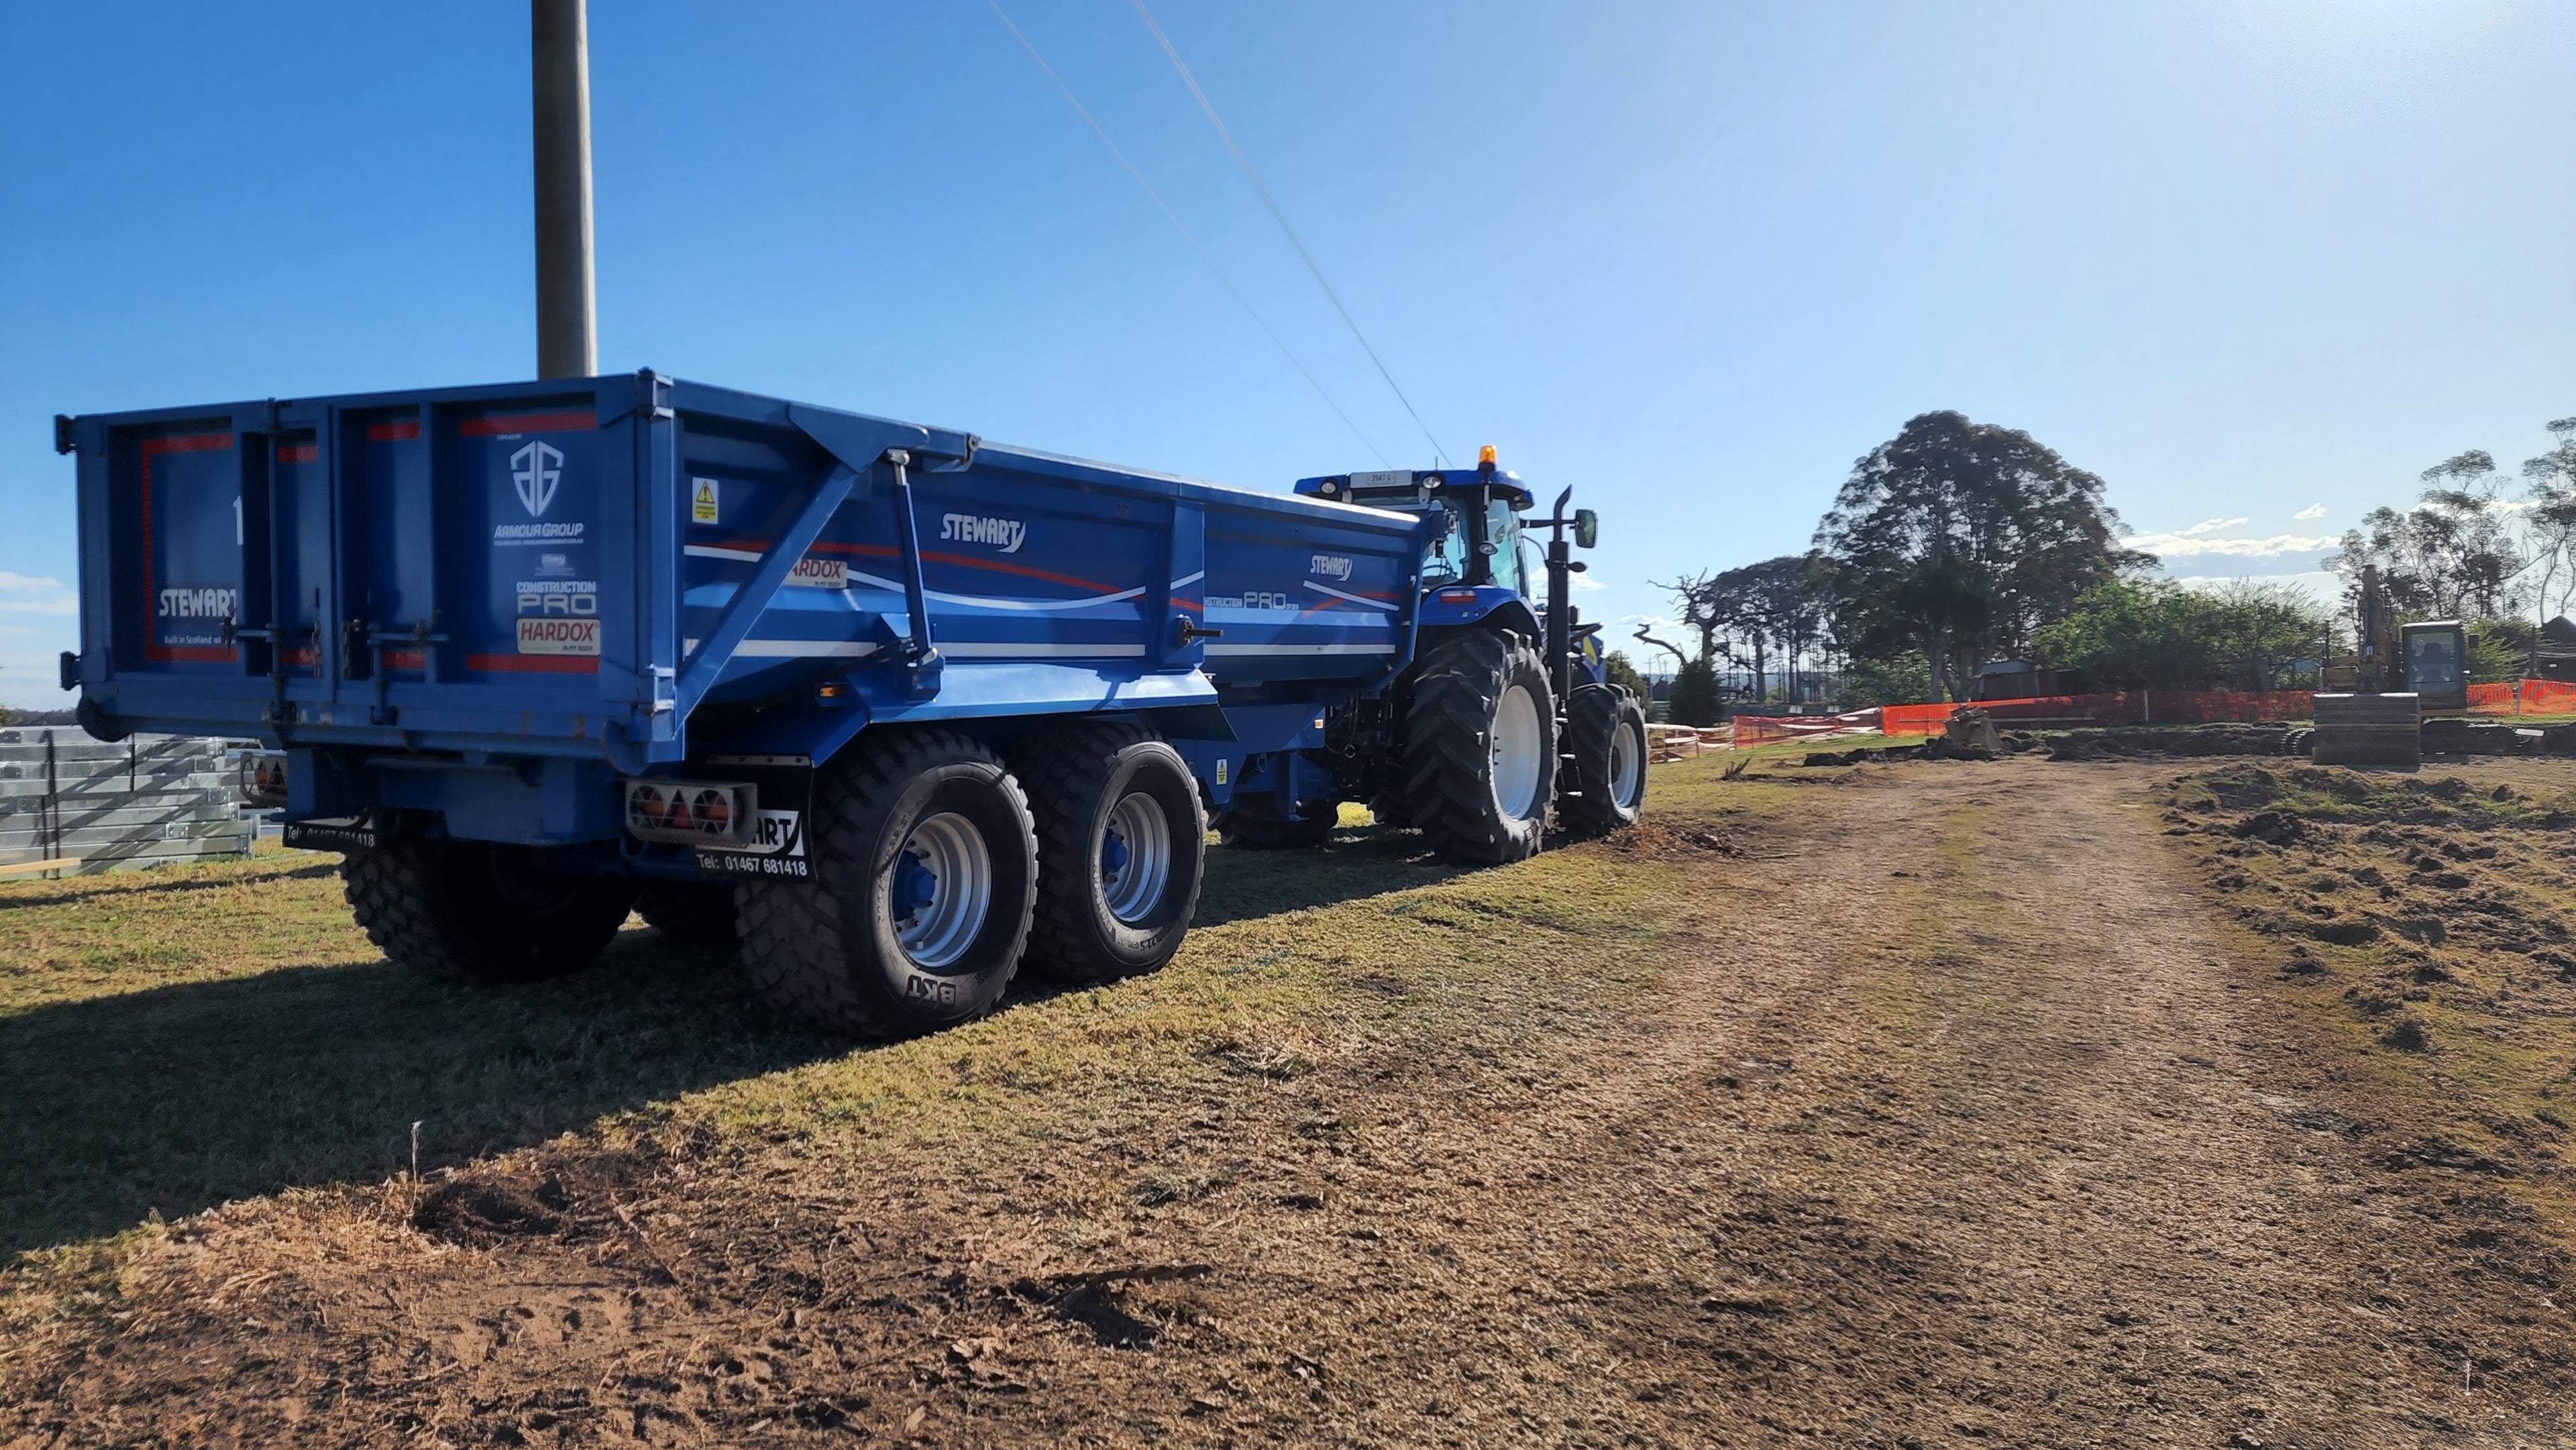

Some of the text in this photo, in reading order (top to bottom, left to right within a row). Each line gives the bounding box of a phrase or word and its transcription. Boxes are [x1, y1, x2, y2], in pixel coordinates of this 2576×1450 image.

[941, 512, 1026, 553] STEWART
[792, 559, 842, 579] ARDOX
[1310, 555, 1353, 581] STEWART
[516, 581, 596, 594] CONSTRUCTION
[517, 594, 596, 615] PRO
[1203, 596, 1242, 608] NSTRUCTION
[1244, 592, 1286, 610] PRO
[521, 622, 595, 642] HARDOX
[696, 854, 807, 876] Tel: 01467 681418
[908, 975, 956, 1006] BKT
